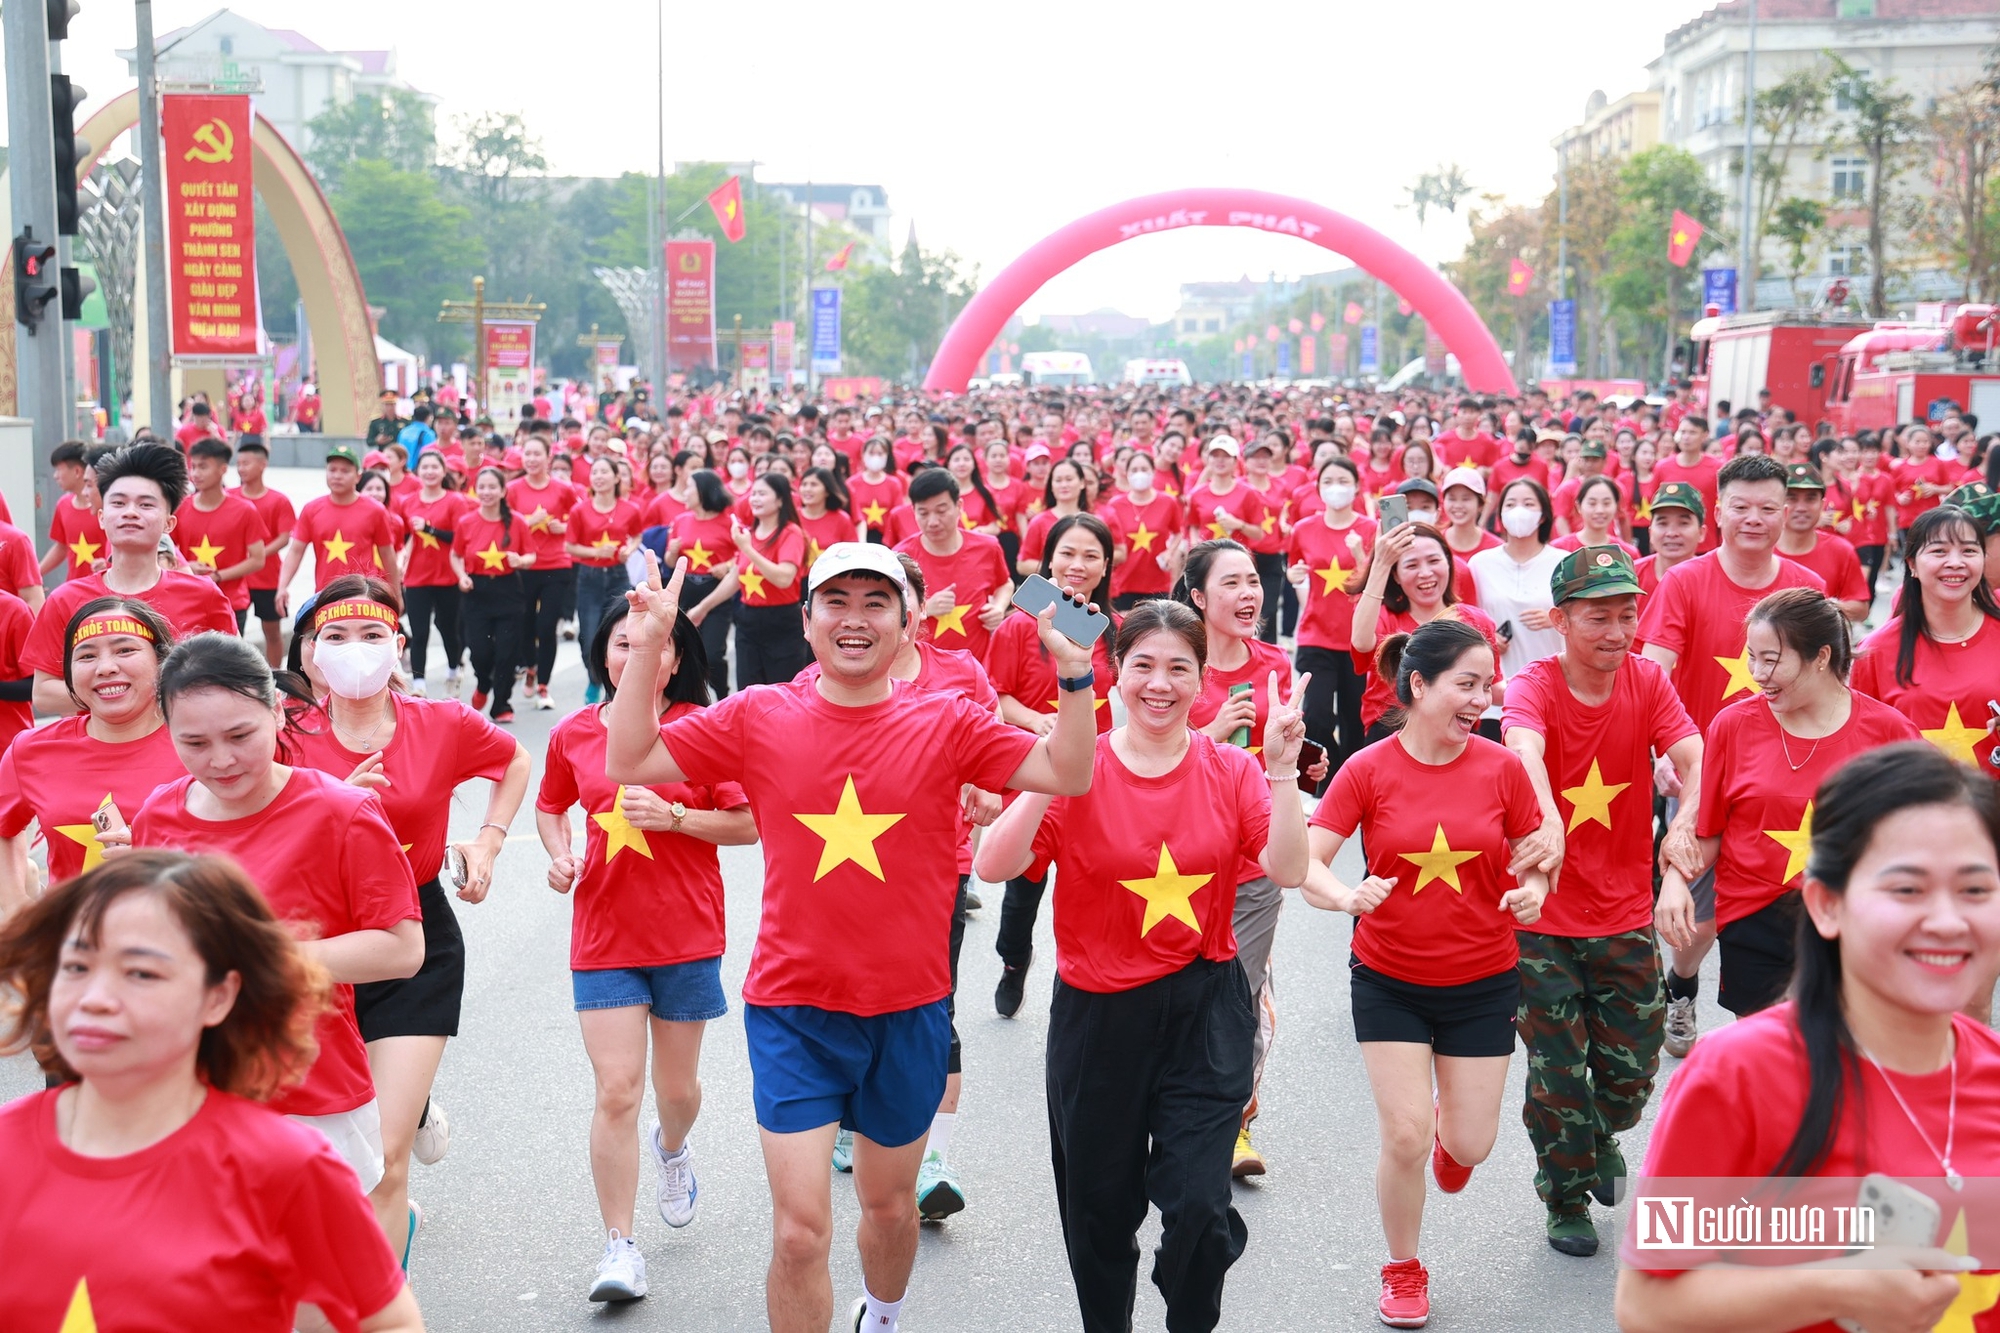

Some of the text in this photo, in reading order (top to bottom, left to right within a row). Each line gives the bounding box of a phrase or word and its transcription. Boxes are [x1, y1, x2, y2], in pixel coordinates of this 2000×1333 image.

[181, 180, 239, 198] QUYẾT TÂM
[184, 200, 237, 220] XÂY DỰNG
[189, 221, 233, 237] PHƯỜNG
[1118, 208, 1209, 239] XUẤT
[182, 240, 241, 258] THÀNH SEN
[183, 260, 242, 278] NGÀY CÀNG
[190, 280, 238, 300] GIÀU ĐẸP
[188, 301, 241, 317] VĂN MINH
[328, 601, 354, 620] KHỎE
[356, 602, 383, 619] TOÀN
[77, 619, 103, 641] KHỎE
[106, 618, 136, 636] TOÀN
